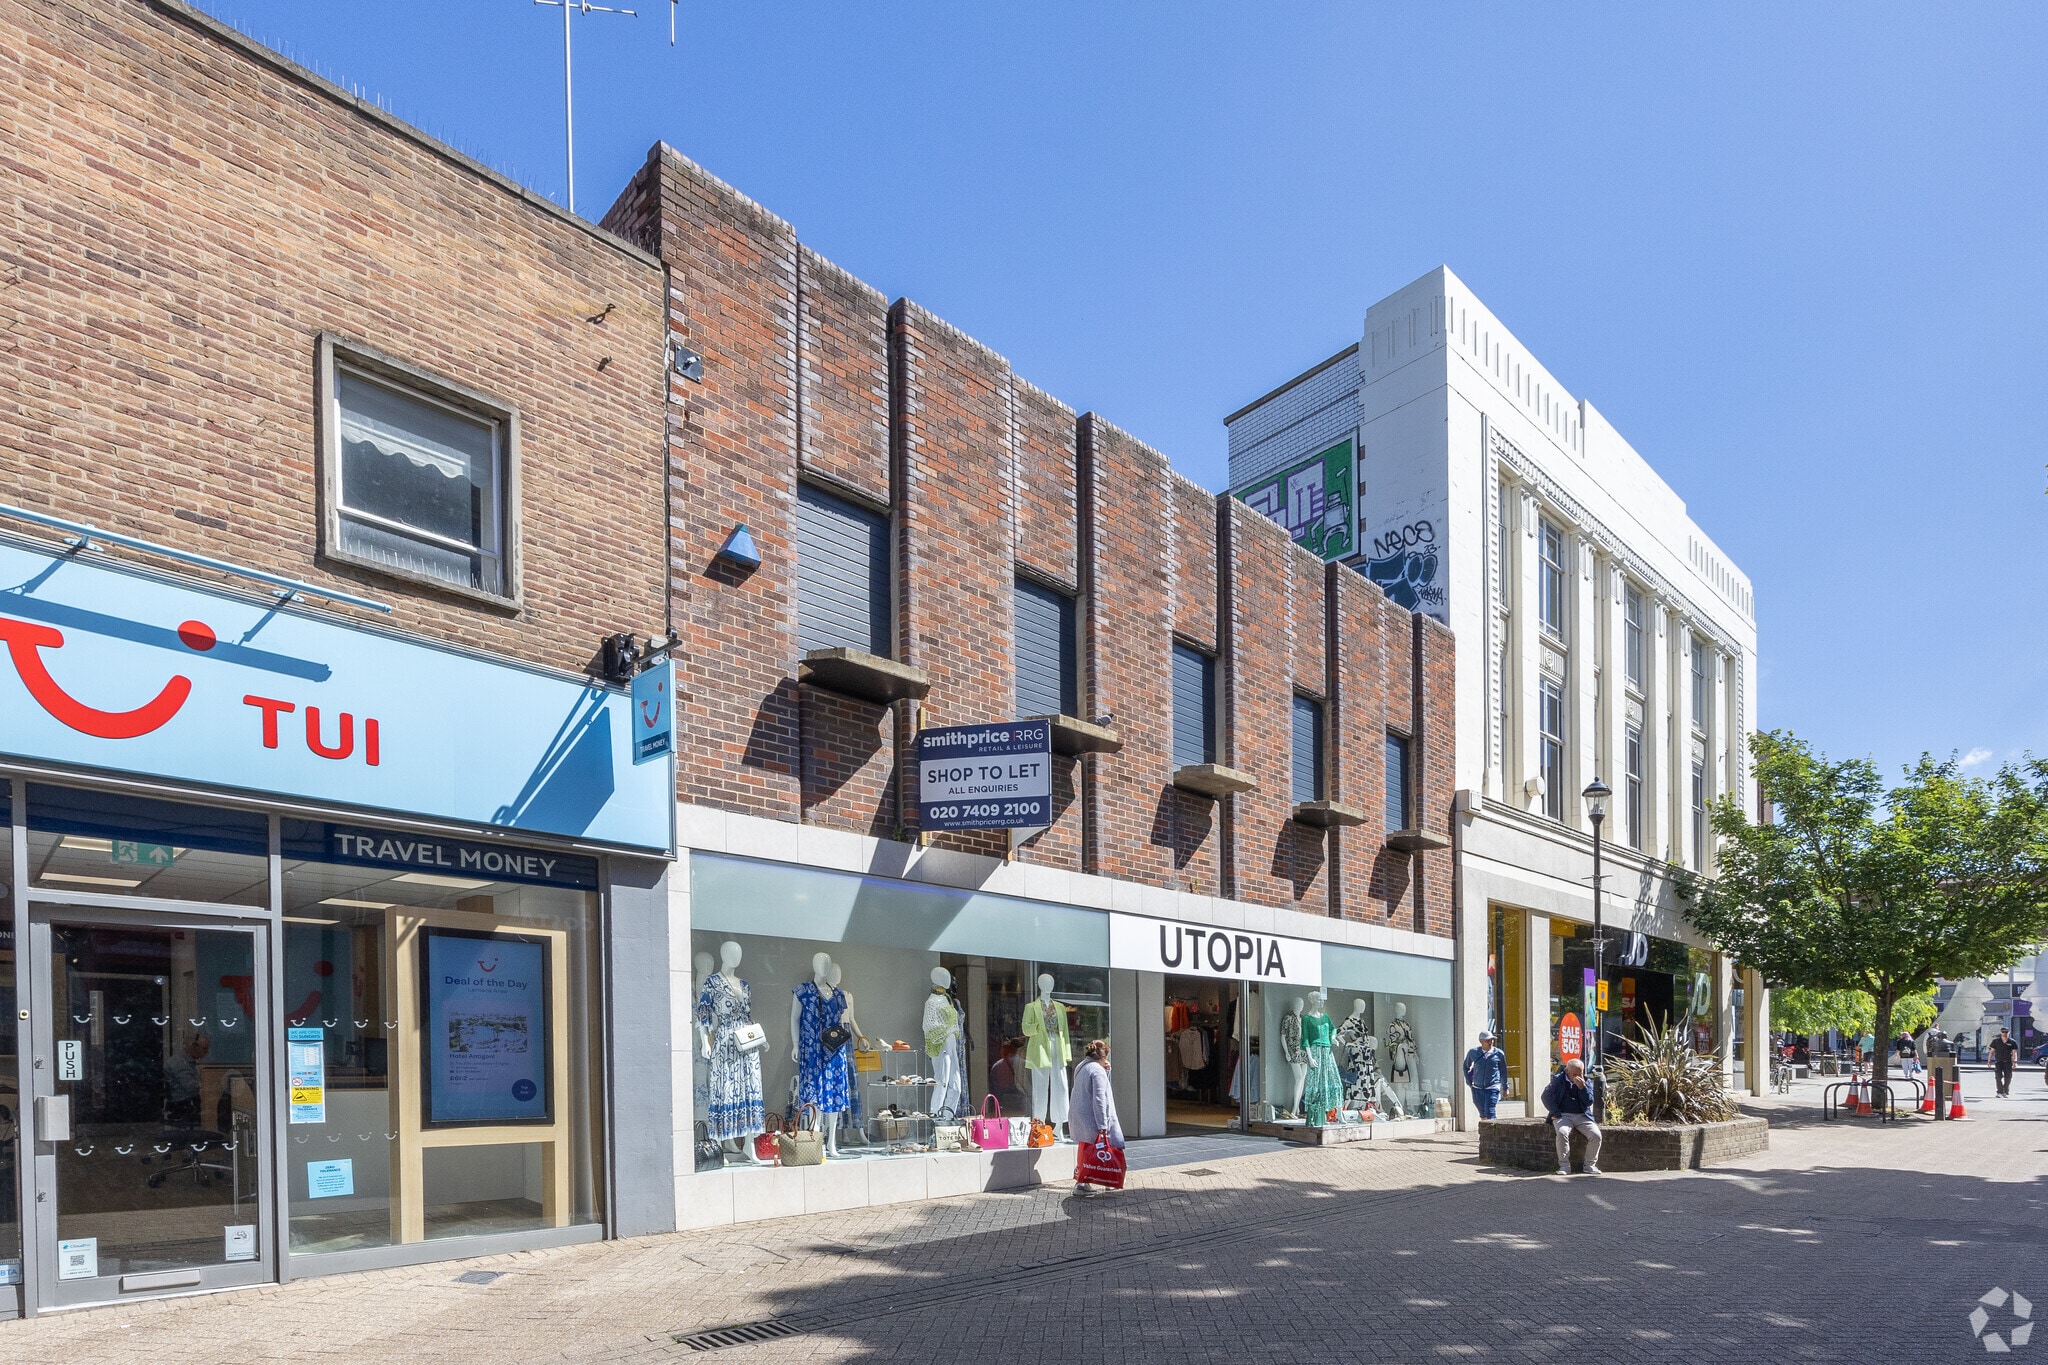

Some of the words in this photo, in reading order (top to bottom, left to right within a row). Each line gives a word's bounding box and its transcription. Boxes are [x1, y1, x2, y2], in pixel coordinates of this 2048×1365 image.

[243, 694, 379, 766] TUI
[923, 730, 1009, 748] smithprice
[1013, 742, 1043, 750] LEISURE
[928, 767, 973, 784] SHOP
[979, 766, 1002, 780] TO
[1009, 763, 1040, 779] LET
[948, 786, 965, 795] ALL
[968, 784, 1019, 794] ENQUIRIES
[930, 806, 958, 819] 020
[963, 804, 999, 817] 7409
[1004, 802, 1040, 816] 2100
[944, 818, 1025, 828] www.smithpricerrg.co.uk
[334, 833, 451, 866] TRAVEL
[459, 848, 557, 877] MONEY
[1160, 925, 1286, 978] UTOPIA
[445, 976, 470, 985] Deal
[473, 977, 484, 986] of
[486, 978, 505, 988] the
[507, 979, 528, 990] Day
[1562, 1025, 1580, 1038] SALE
[65, 1042, 75, 1078] PUSH
